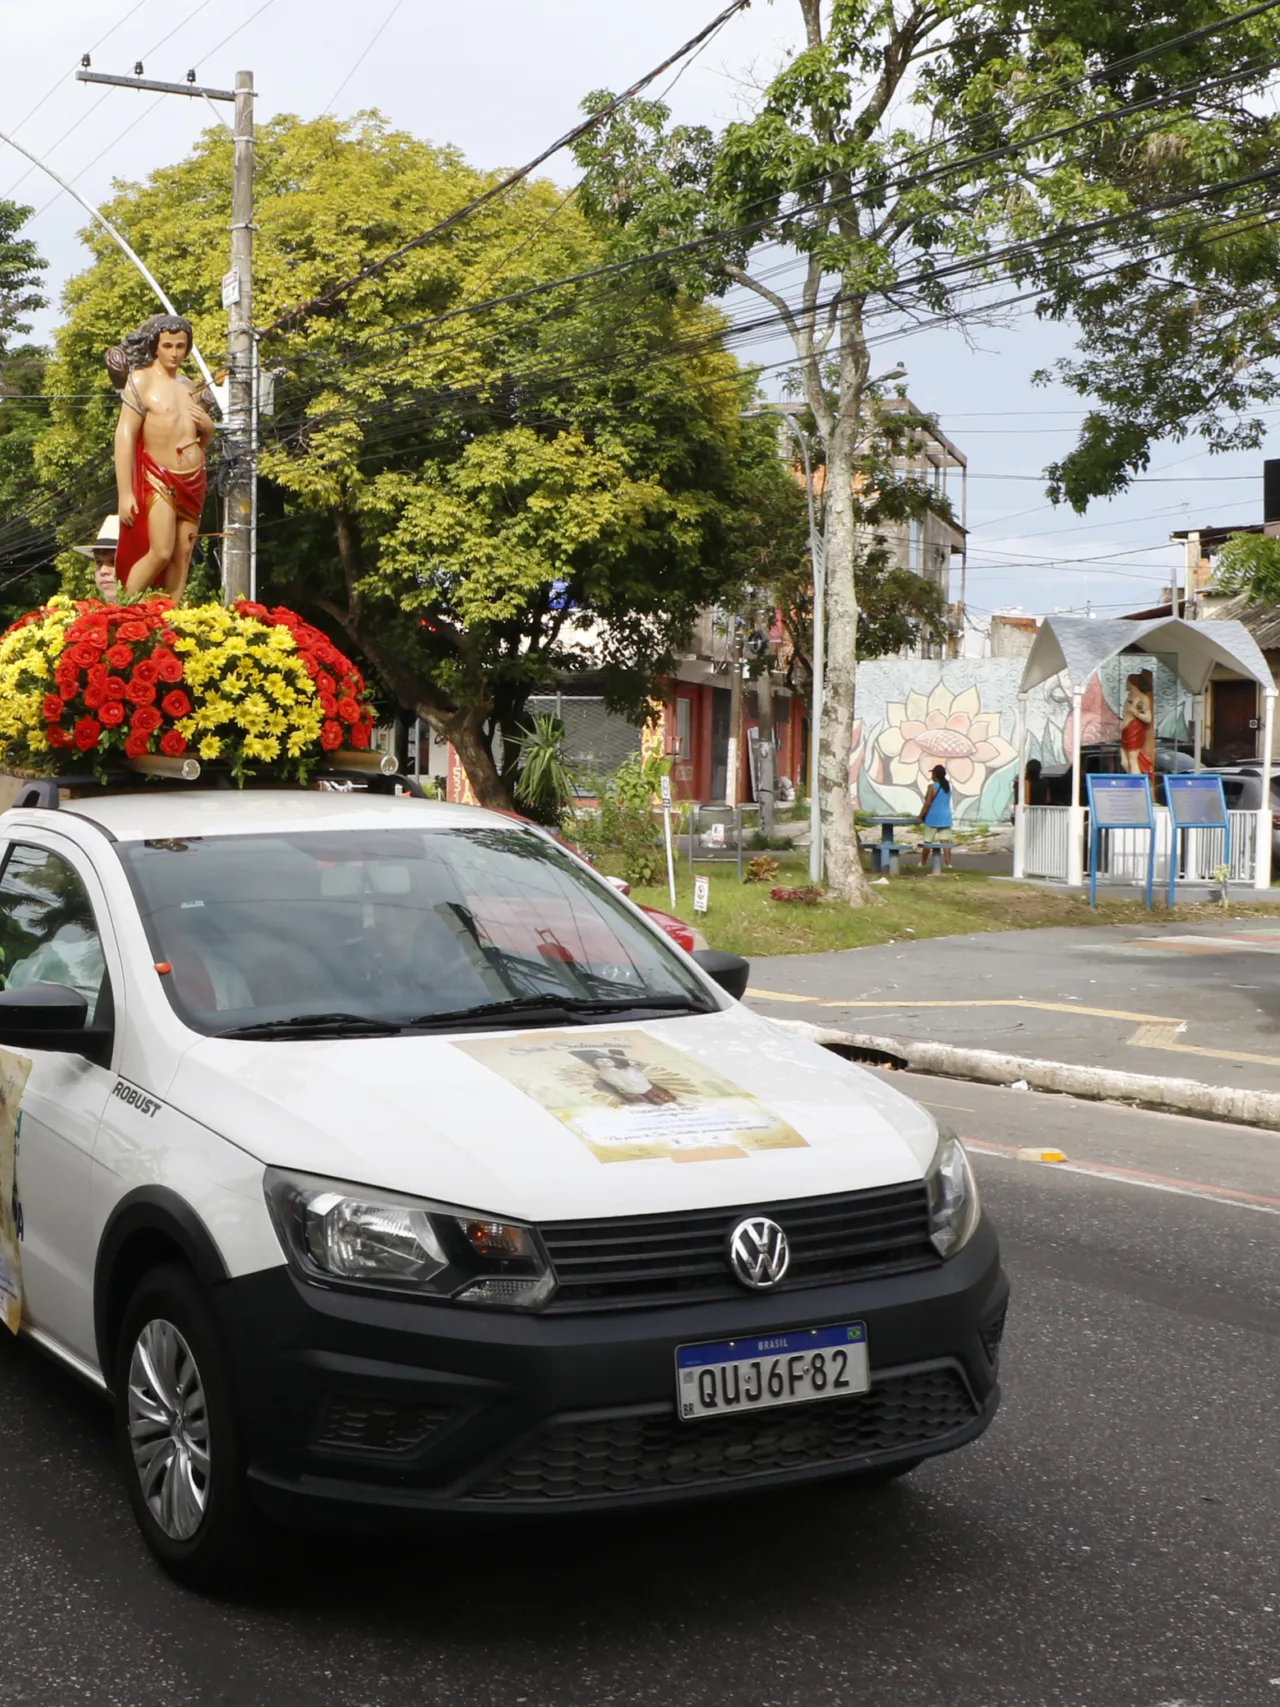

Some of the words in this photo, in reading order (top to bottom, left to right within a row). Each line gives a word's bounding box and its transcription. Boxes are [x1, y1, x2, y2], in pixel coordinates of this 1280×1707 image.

[112, 1081, 162, 1118] ROBUST
[758, 1338, 789, 1351] BRASIL
[698, 1349, 850, 1408] QUJ6F82
[683, 1403, 695, 1416] BR
